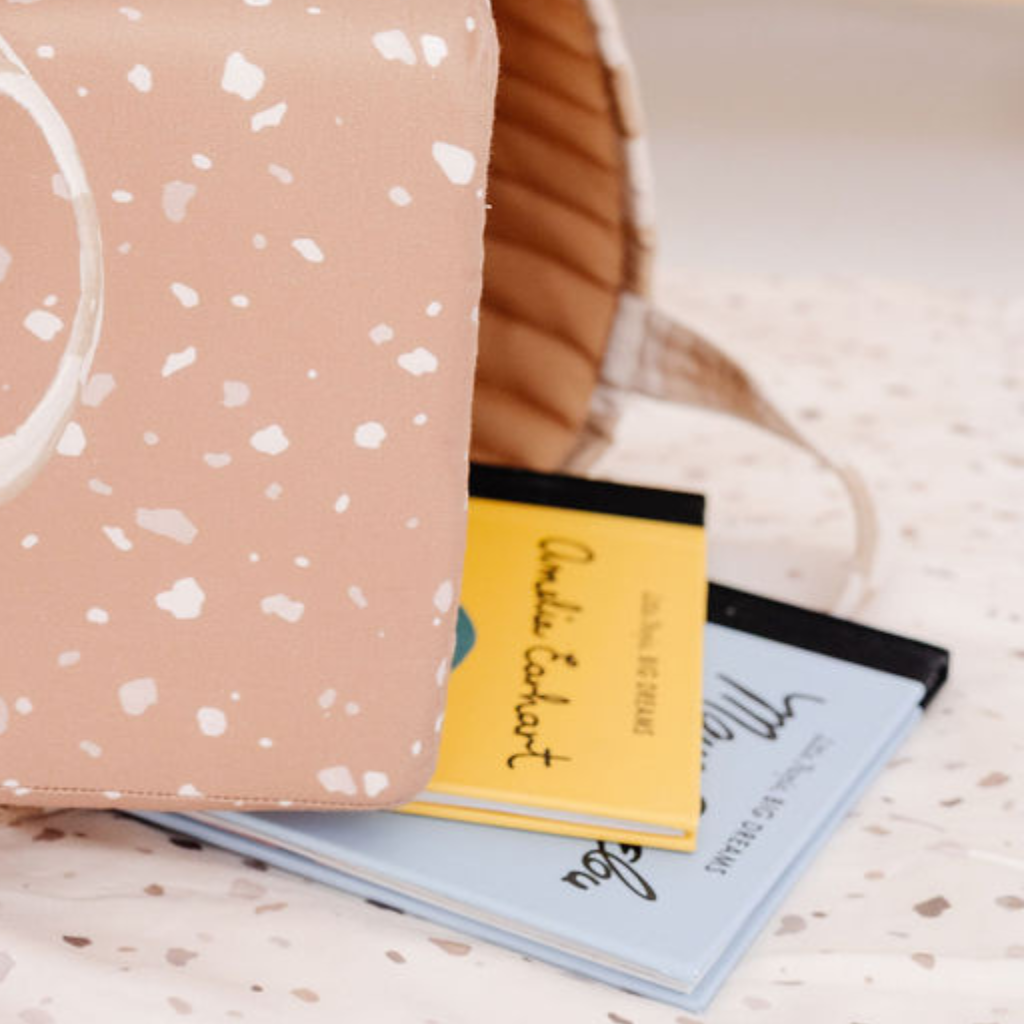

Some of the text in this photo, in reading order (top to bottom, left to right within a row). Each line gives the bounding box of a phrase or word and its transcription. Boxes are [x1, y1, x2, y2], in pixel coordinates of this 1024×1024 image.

[506, 645, 579, 770] Earhart
[704, 794, 785, 876] BIG DREAMS
